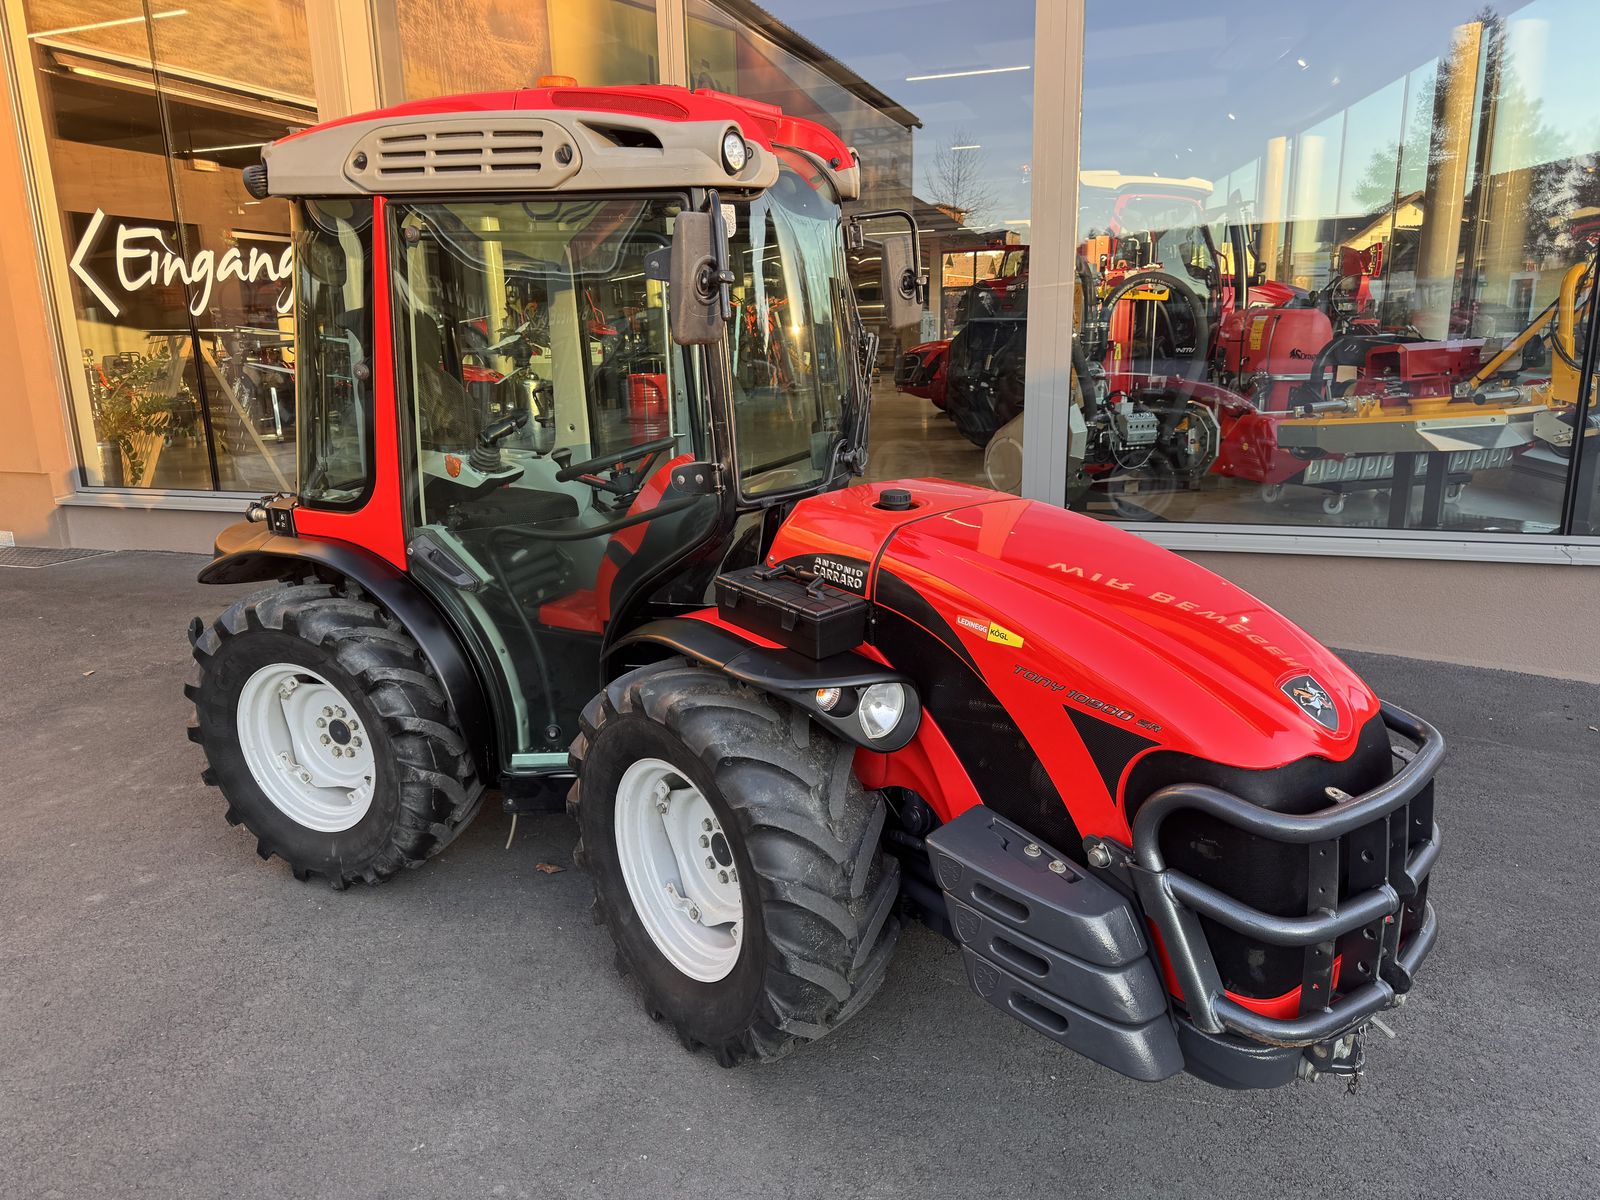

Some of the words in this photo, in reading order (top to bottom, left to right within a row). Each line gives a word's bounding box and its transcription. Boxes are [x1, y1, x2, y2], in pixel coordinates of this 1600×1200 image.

[116, 223, 295, 317] Eingang
[812, 564, 863, 589] CARRARO
[813, 556, 864, 578] ANTONIO
[957, 616, 988, 634] LEDINEGG
[989, 628, 1009, 641] KÖGL
[1066, 689, 1135, 721] 10900
[1135, 719, 1163, 733] SR
